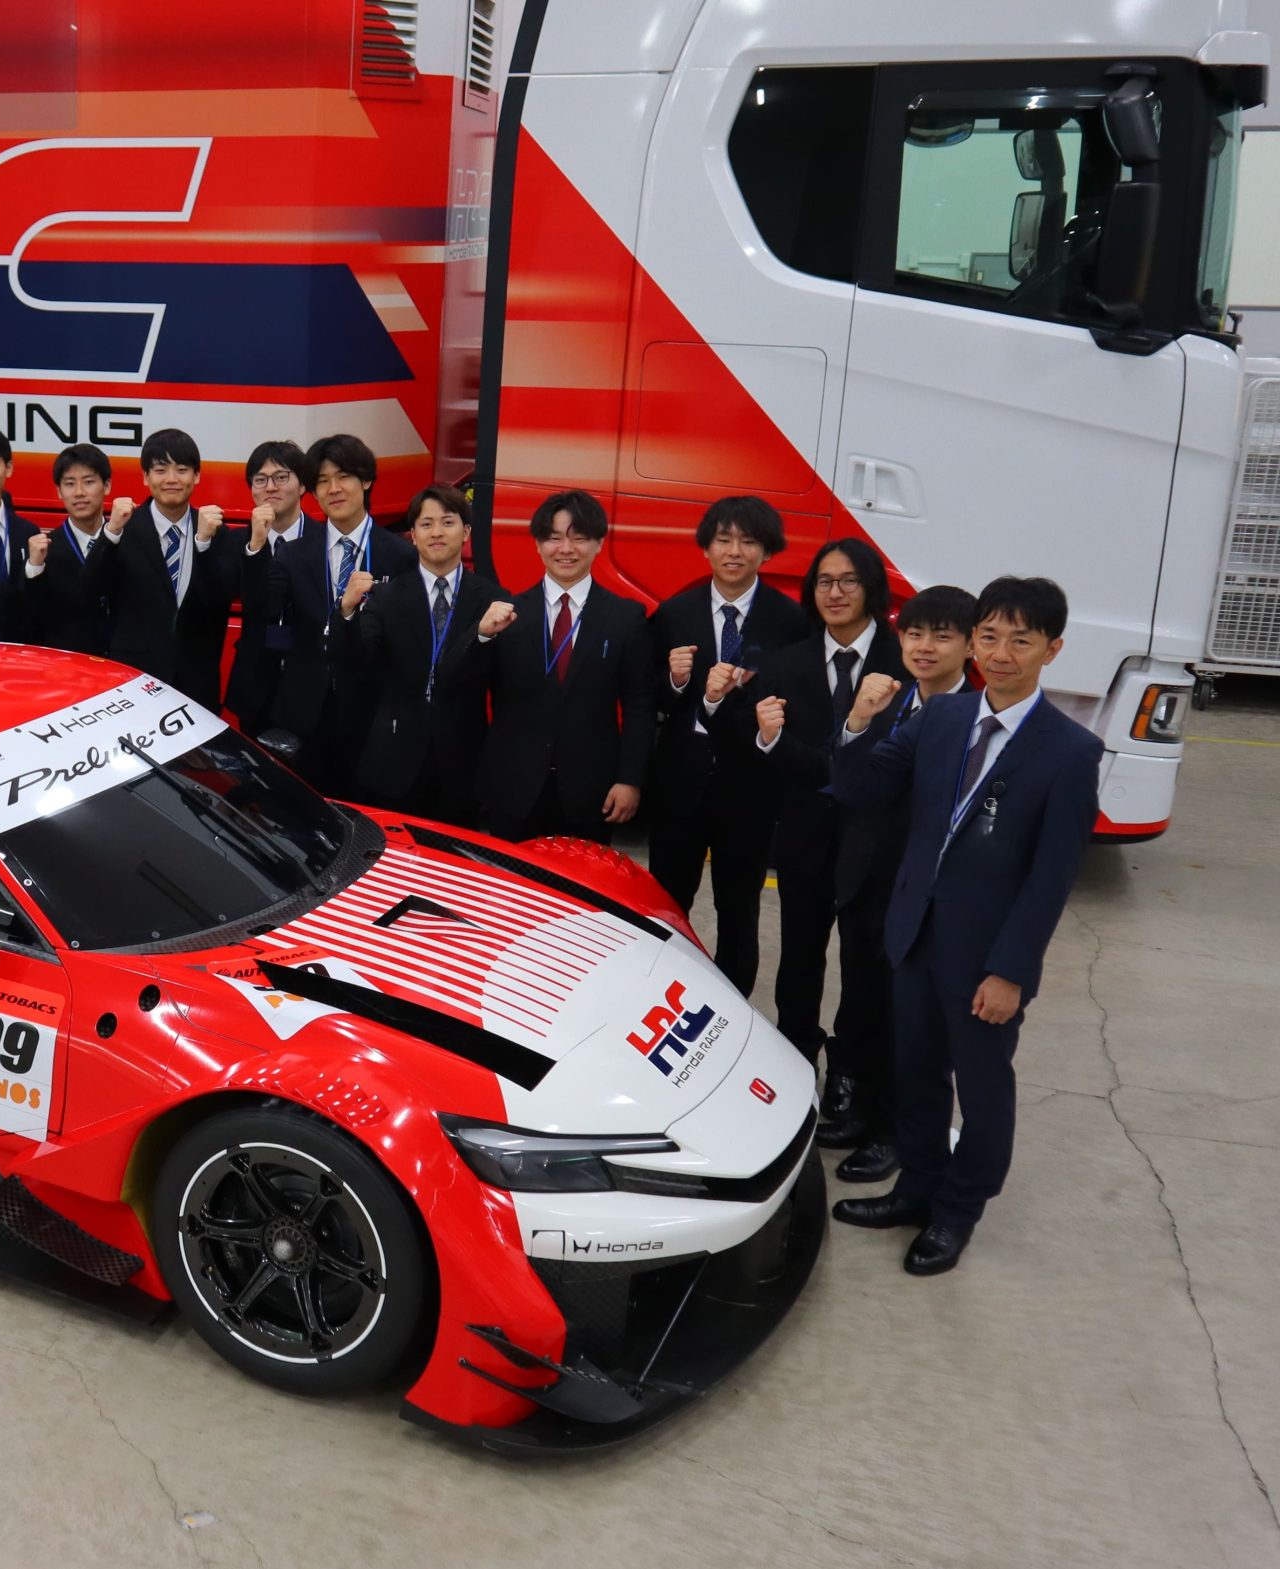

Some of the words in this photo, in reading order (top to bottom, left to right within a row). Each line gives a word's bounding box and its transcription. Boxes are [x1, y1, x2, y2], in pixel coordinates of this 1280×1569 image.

[59, 697, 135, 732] Honda
[625, 979, 716, 1078] HRC
[671, 1050, 705, 1089] Honda
[699, 1015, 730, 1054] RACING
[596, 1240, 664, 1253] Honda
